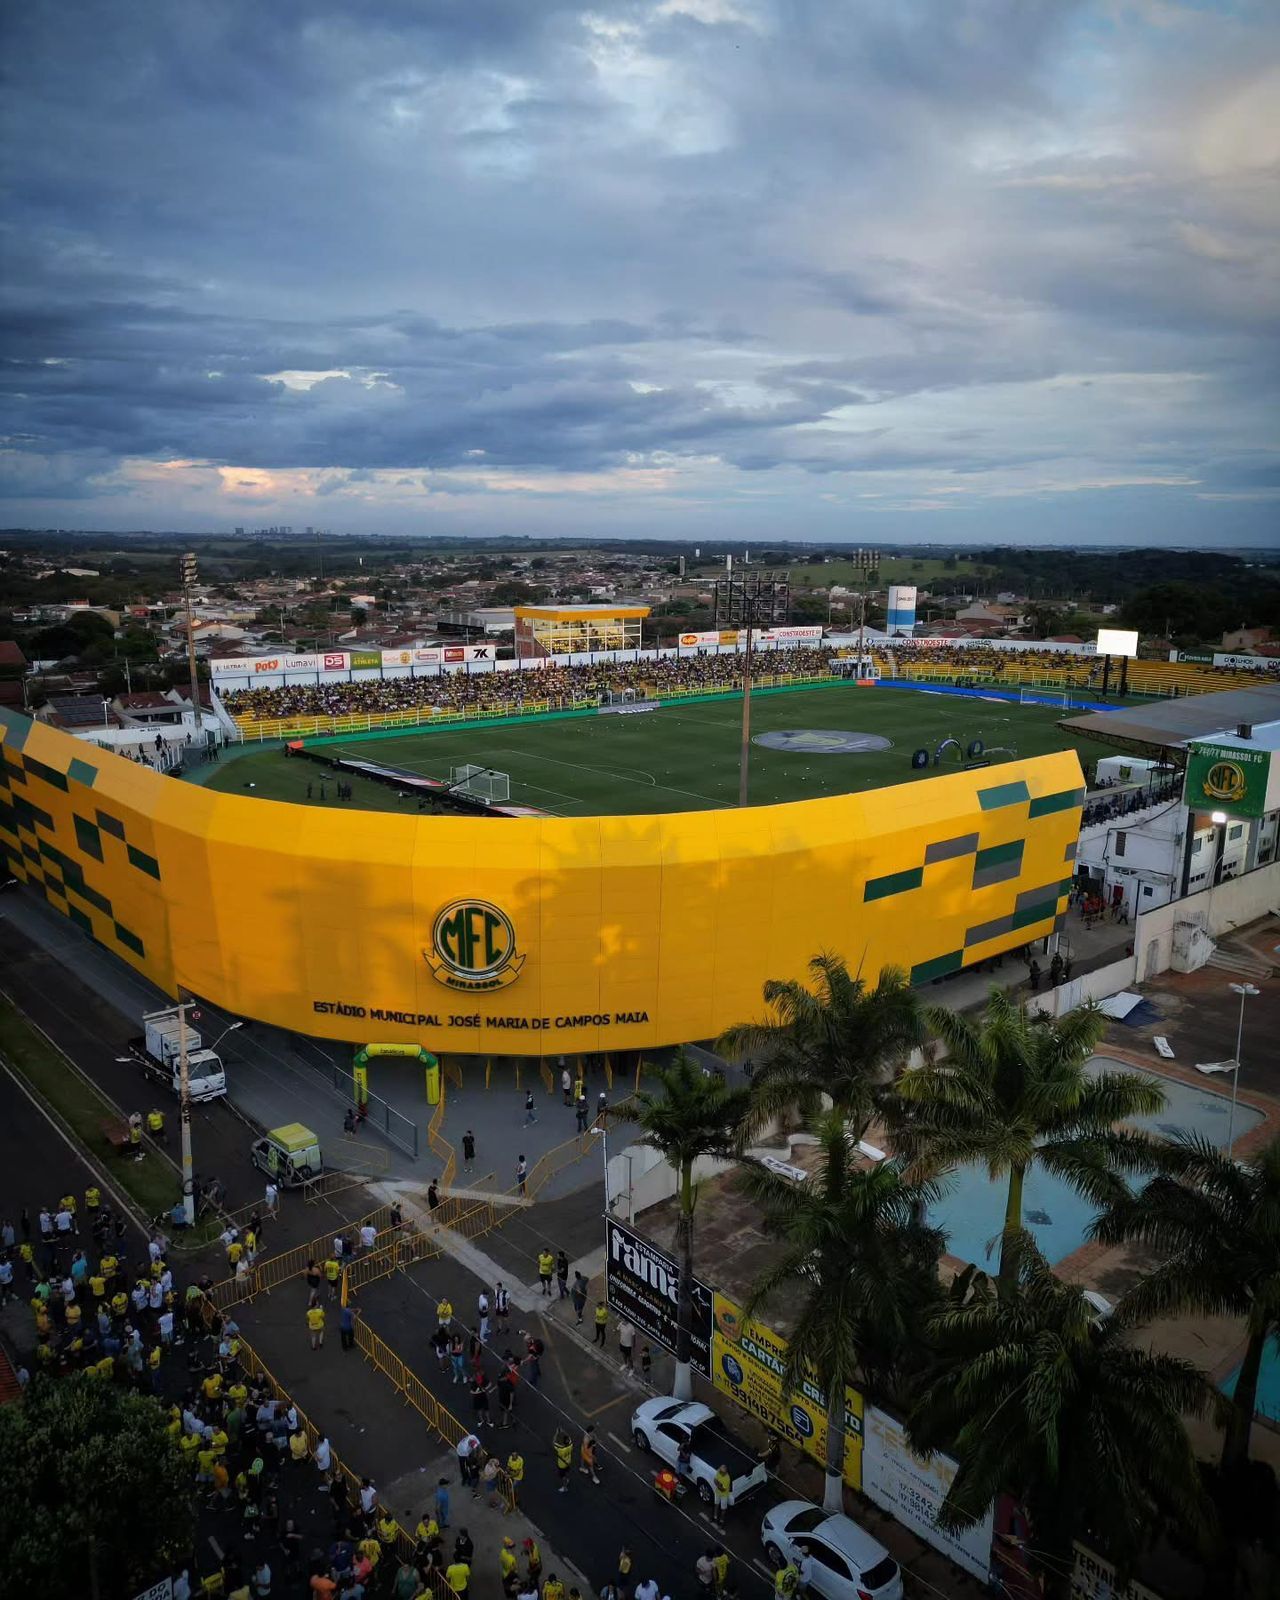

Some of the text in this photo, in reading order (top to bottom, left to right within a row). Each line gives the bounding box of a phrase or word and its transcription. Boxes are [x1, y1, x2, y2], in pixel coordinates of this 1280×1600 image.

[473, 649, 488, 658] 7K
[255, 659, 279, 673] Poty
[286, 659, 316, 668] Lumavi
[325, 657, 343, 666] DS
[1220, 750, 1251, 762] MIRASSOL
[1253, 755, 1263, 764] FC
[441, 908, 503, 969] MFC
[446, 976, 503, 988] MIRASSOL
[370, 1008, 442, 1026] MUNICIPAL
[448, 1013, 481, 1027] JOSÉ
[486, 1016, 529, 1029] MARIA
[532, 1018, 551, 1029] DE
[555, 1014, 611, 1027] CAMPOS
[616, 1011, 649, 1024] MAIA
[635, 1241, 674, 1275] ESTAMPARIA
